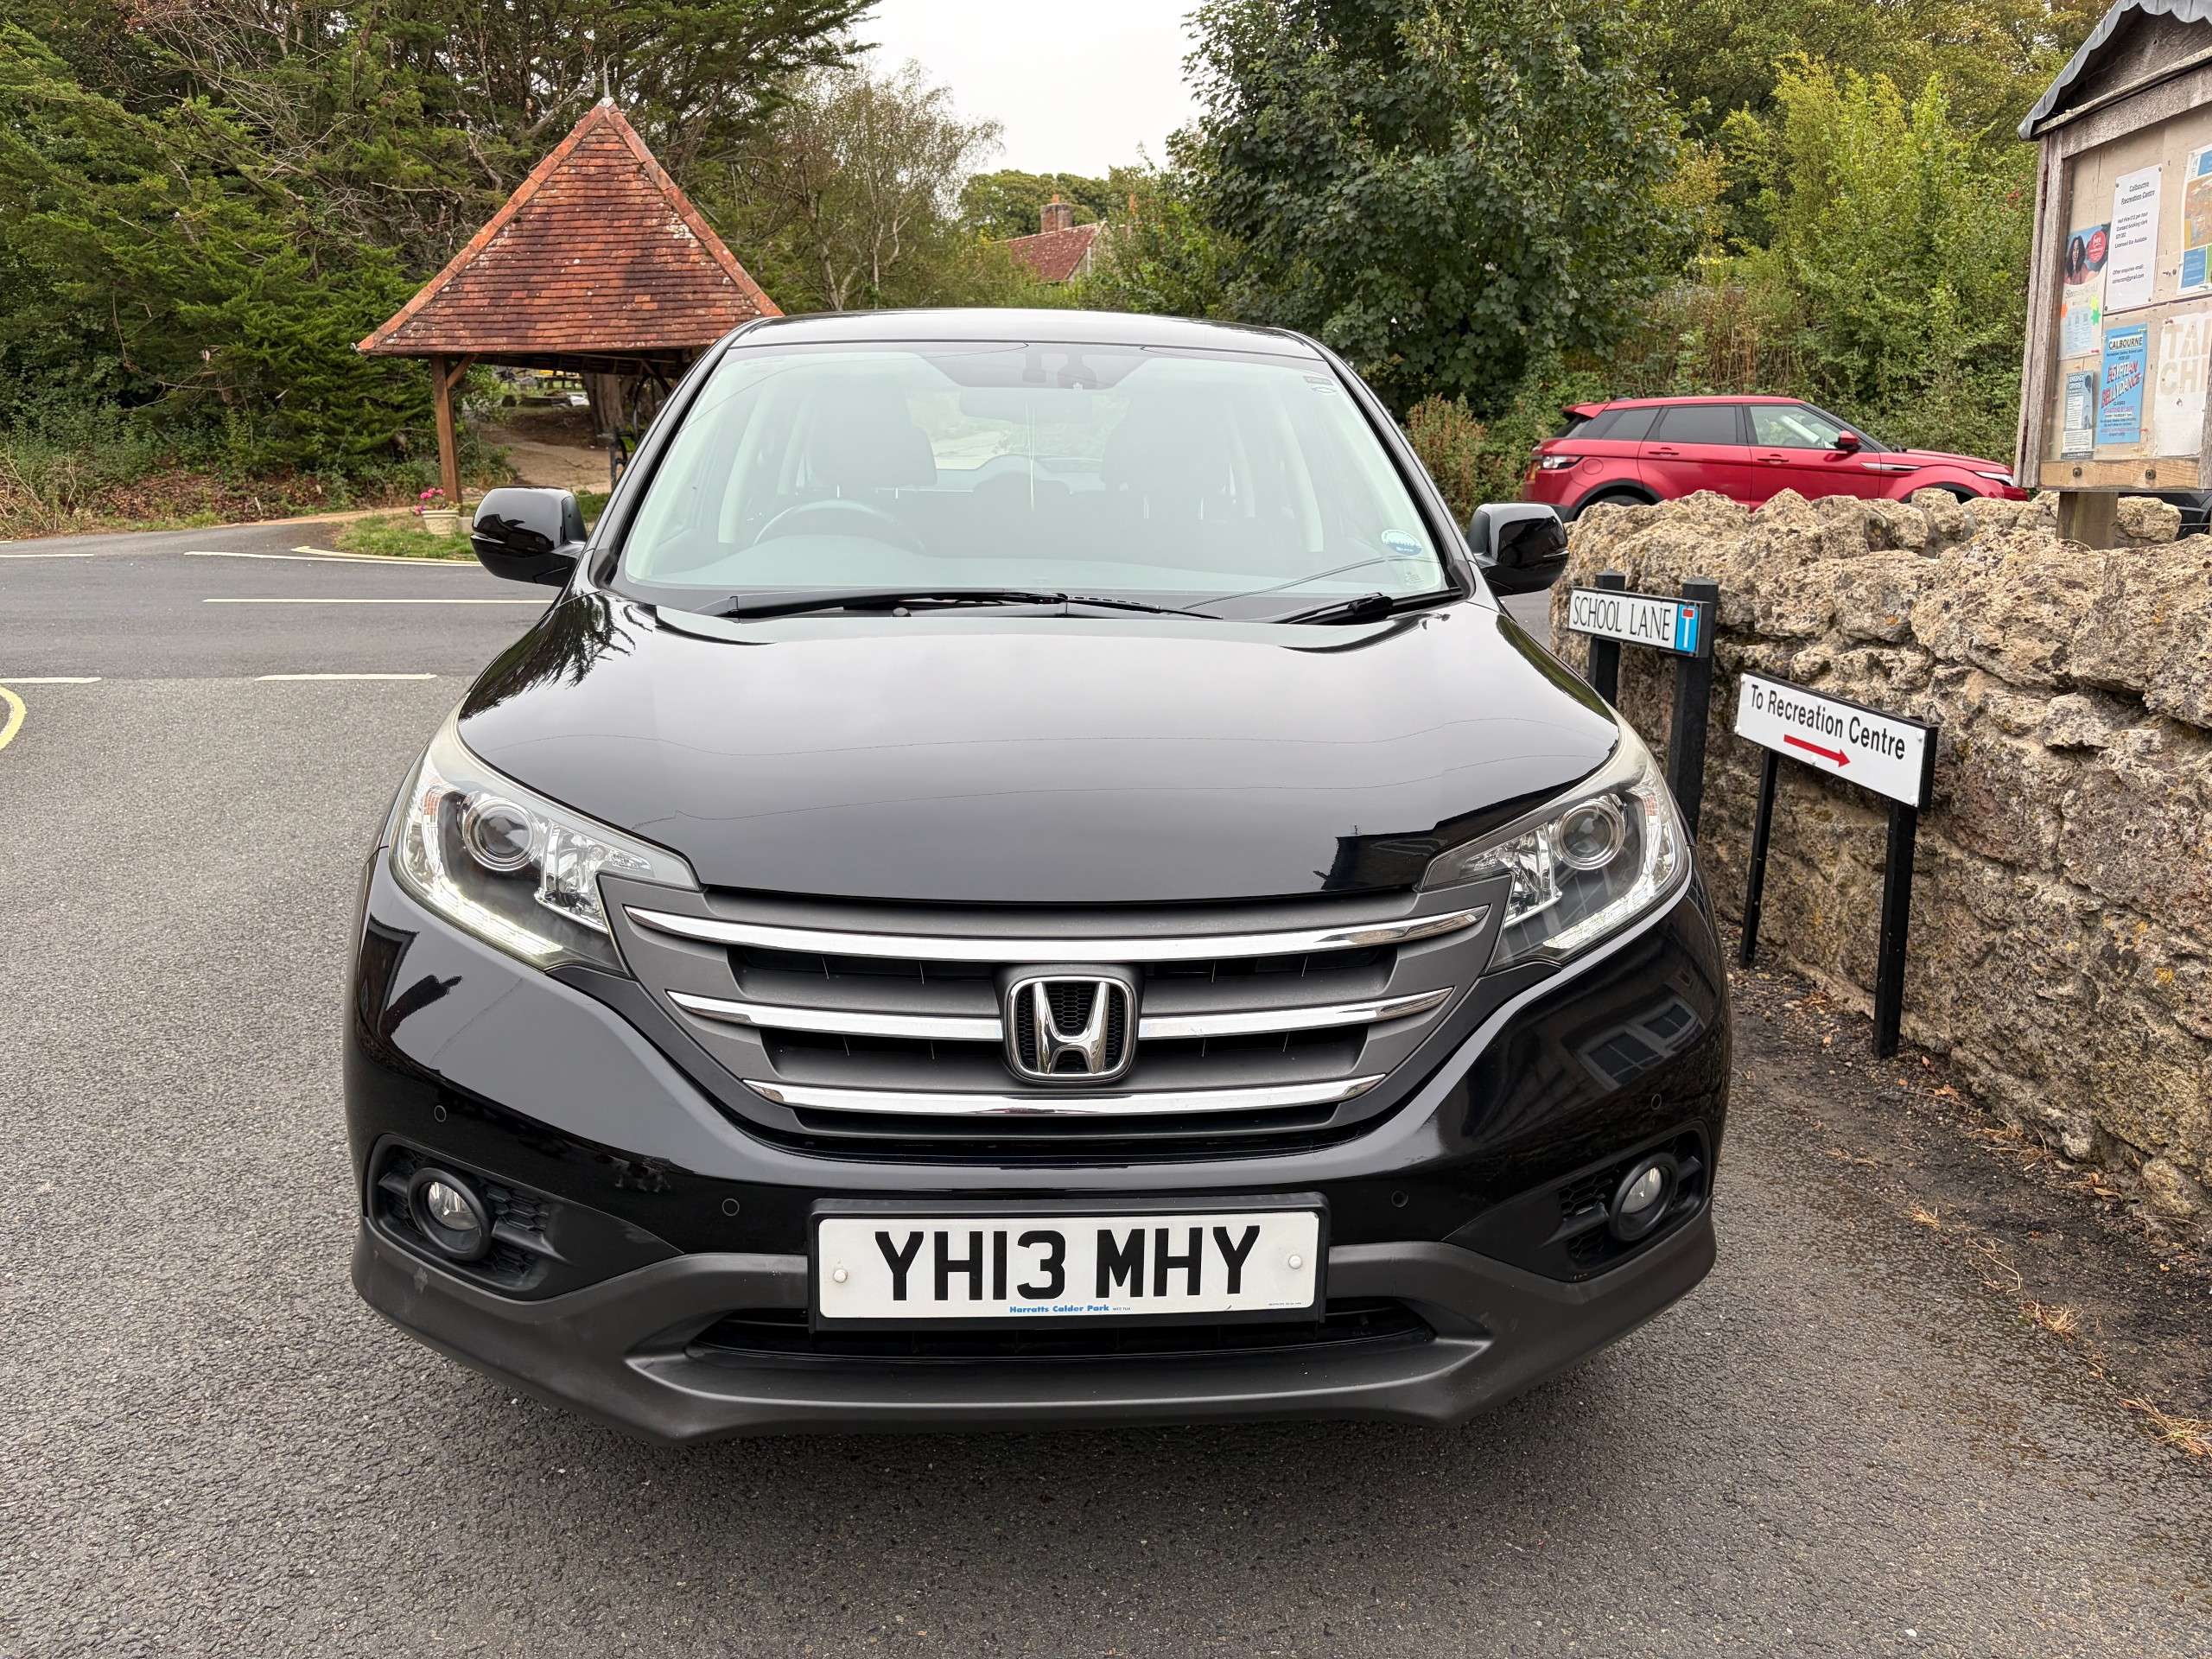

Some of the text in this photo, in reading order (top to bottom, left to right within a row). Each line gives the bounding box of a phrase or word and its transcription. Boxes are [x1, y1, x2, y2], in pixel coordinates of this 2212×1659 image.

[2108, 337, 2143, 350] CALBOURNE
[2160, 356, 2209, 395] CHI
[1573, 595, 1672, 641] SCHOOL LANE
[1751, 683, 1906, 760] To Recreation Centre
[874, 1224, 1261, 1301] YH13 MHY
[1052, 1304, 1084, 1313] Calder
